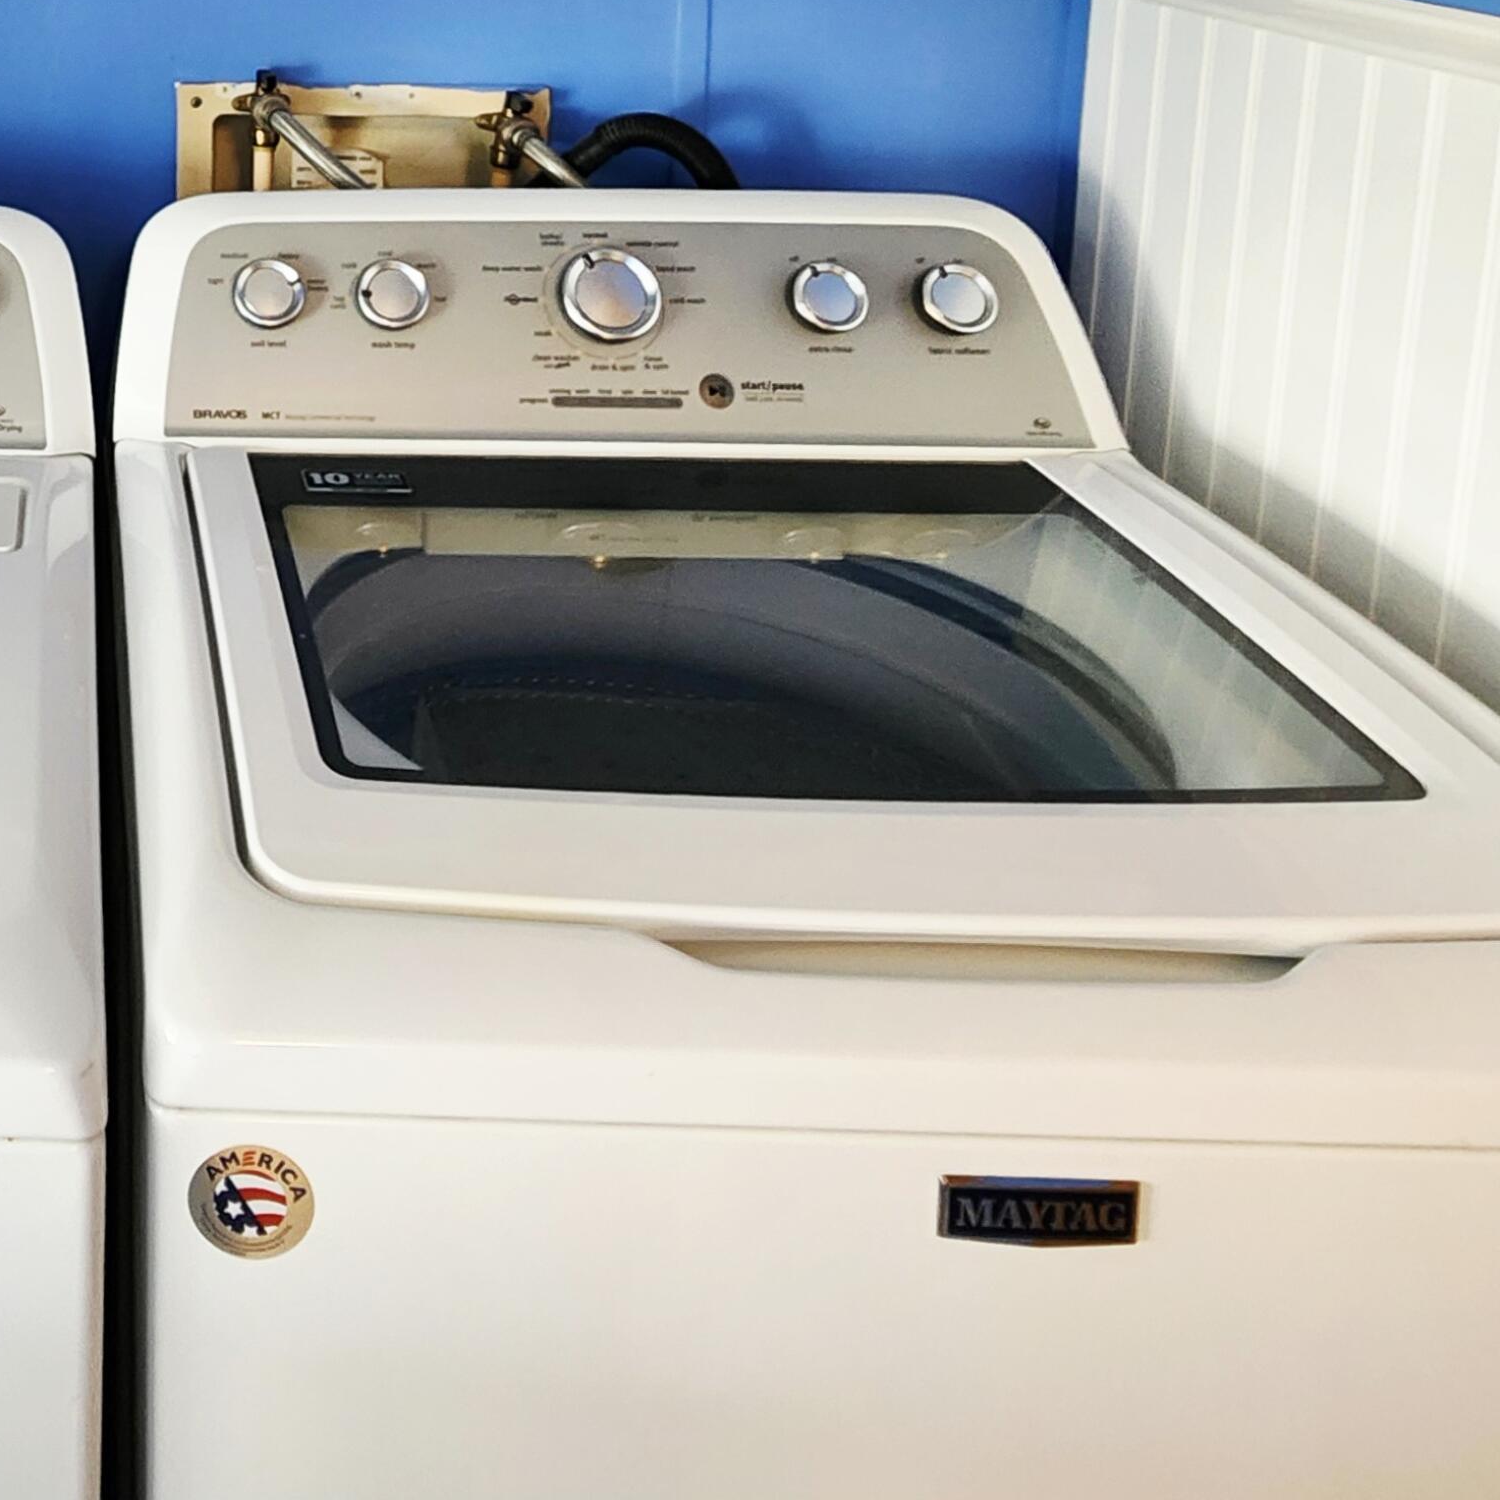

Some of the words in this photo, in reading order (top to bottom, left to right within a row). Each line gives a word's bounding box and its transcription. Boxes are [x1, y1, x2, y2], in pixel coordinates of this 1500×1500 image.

[741, 380, 804, 393] start/pause
[192, 409, 248, 420] BRAVOS
[309, 472, 350, 485] 10
[205, 1151, 308, 1203] AMERICA
[955, 1197, 1127, 1232] MAYTAG
